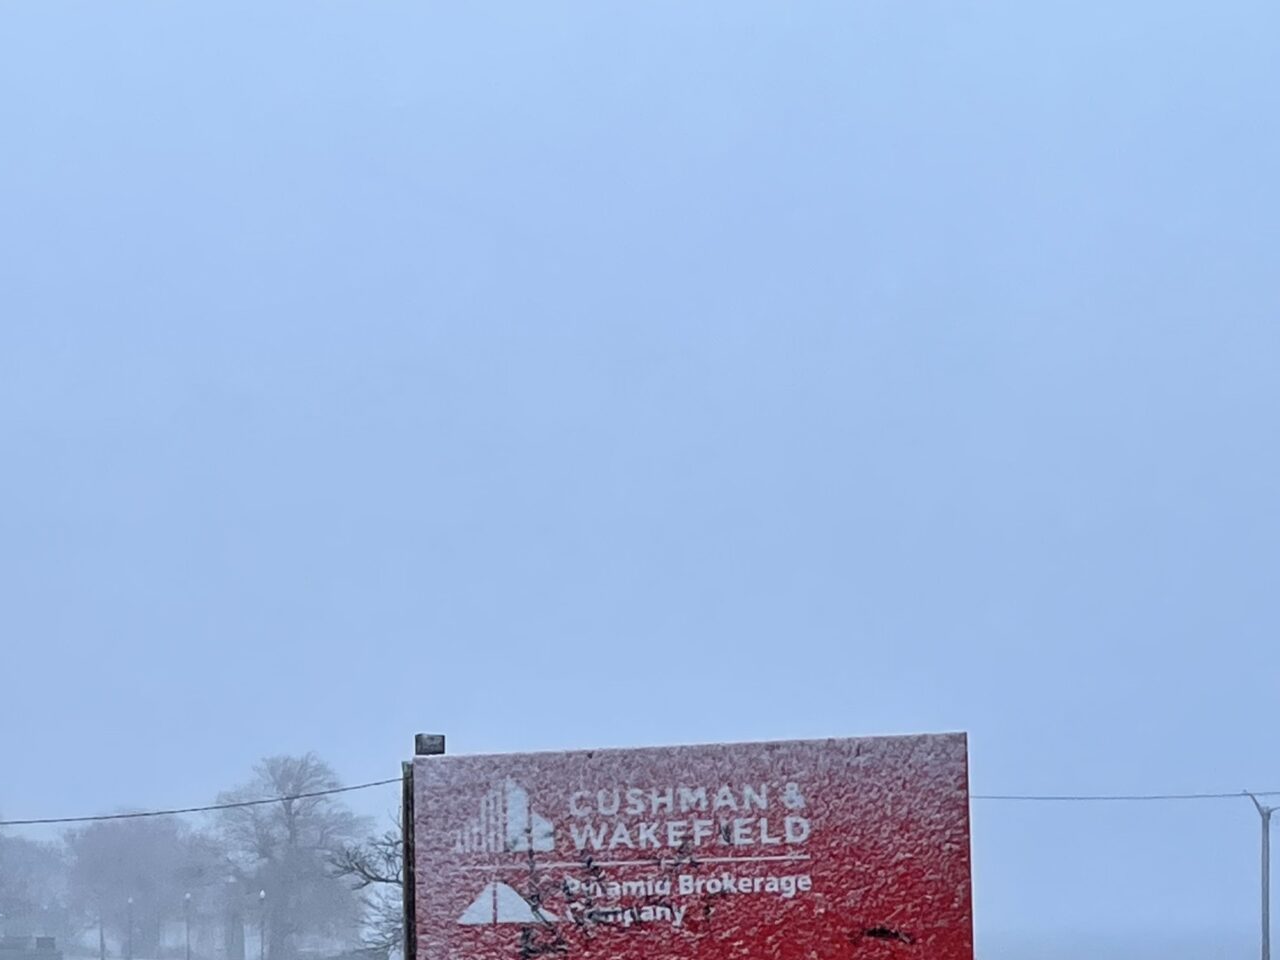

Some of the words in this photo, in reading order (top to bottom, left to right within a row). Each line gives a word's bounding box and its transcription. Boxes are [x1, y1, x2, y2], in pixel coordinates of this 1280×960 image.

[569, 783, 769, 817] CUSHMAN
[782, 781, 806, 809] &
[571, 816, 812, 850] WAKEFIELD
[678, 873, 813, 899] Brokerage
